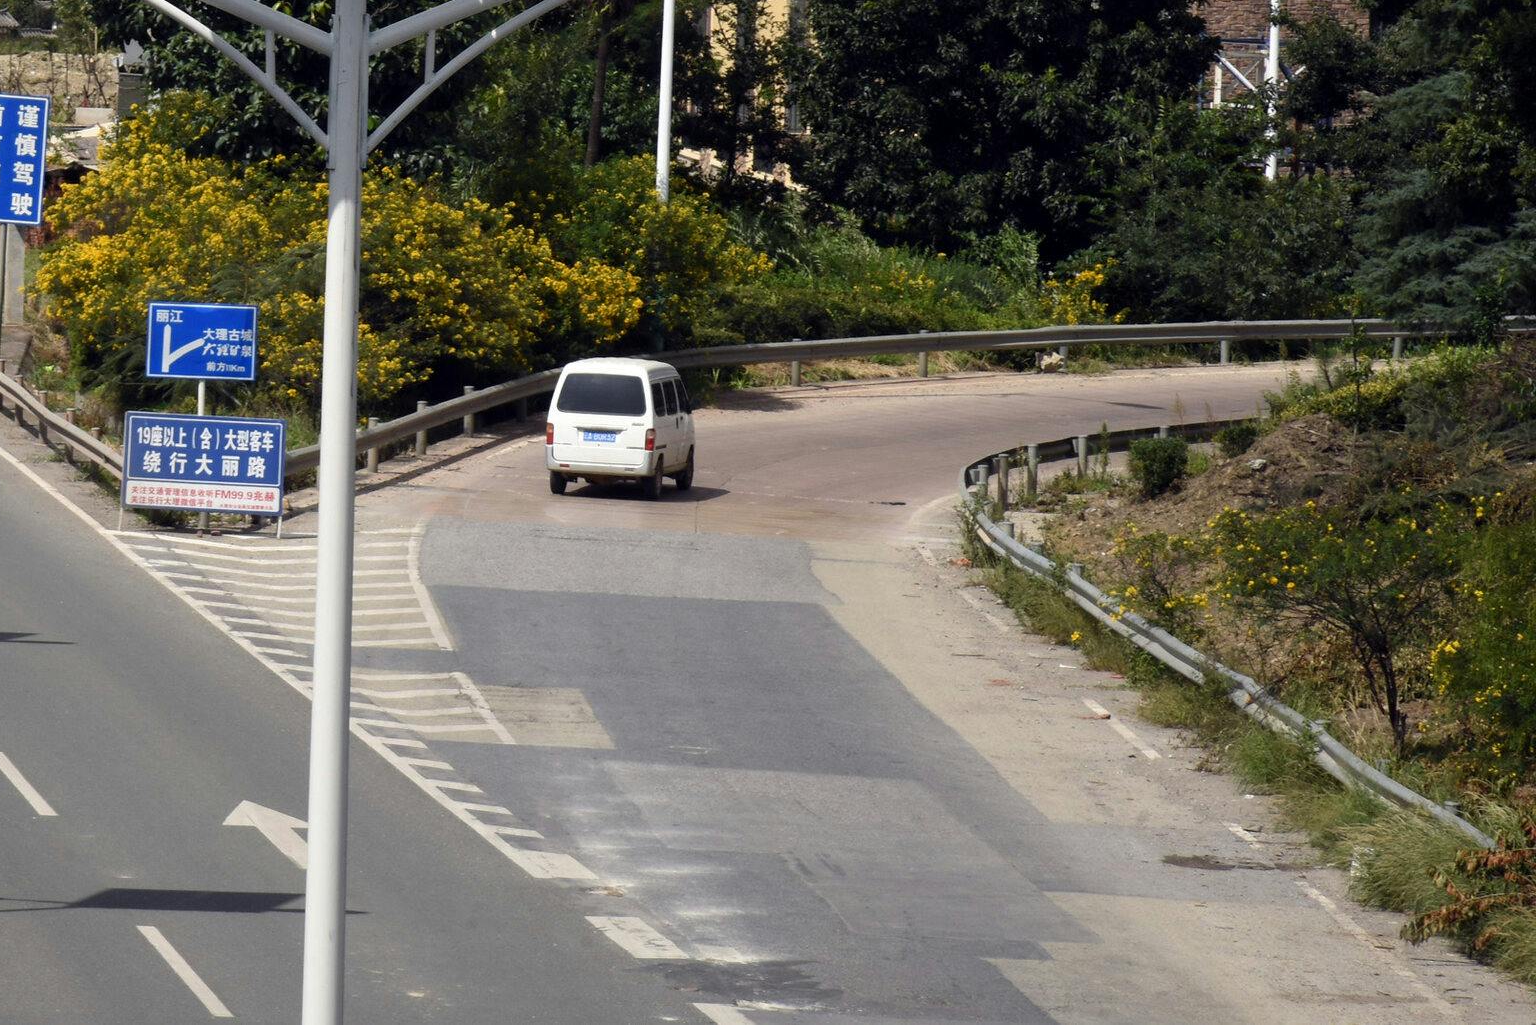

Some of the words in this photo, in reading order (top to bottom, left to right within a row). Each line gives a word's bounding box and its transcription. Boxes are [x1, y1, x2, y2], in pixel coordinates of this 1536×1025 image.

[10, 104, 41, 216] 谨慎驾驶
[156, 309, 184, 323] 丽江
[203, 328, 253, 342] 大理古城
[143, 450, 266, 478] 绕行大丽路
